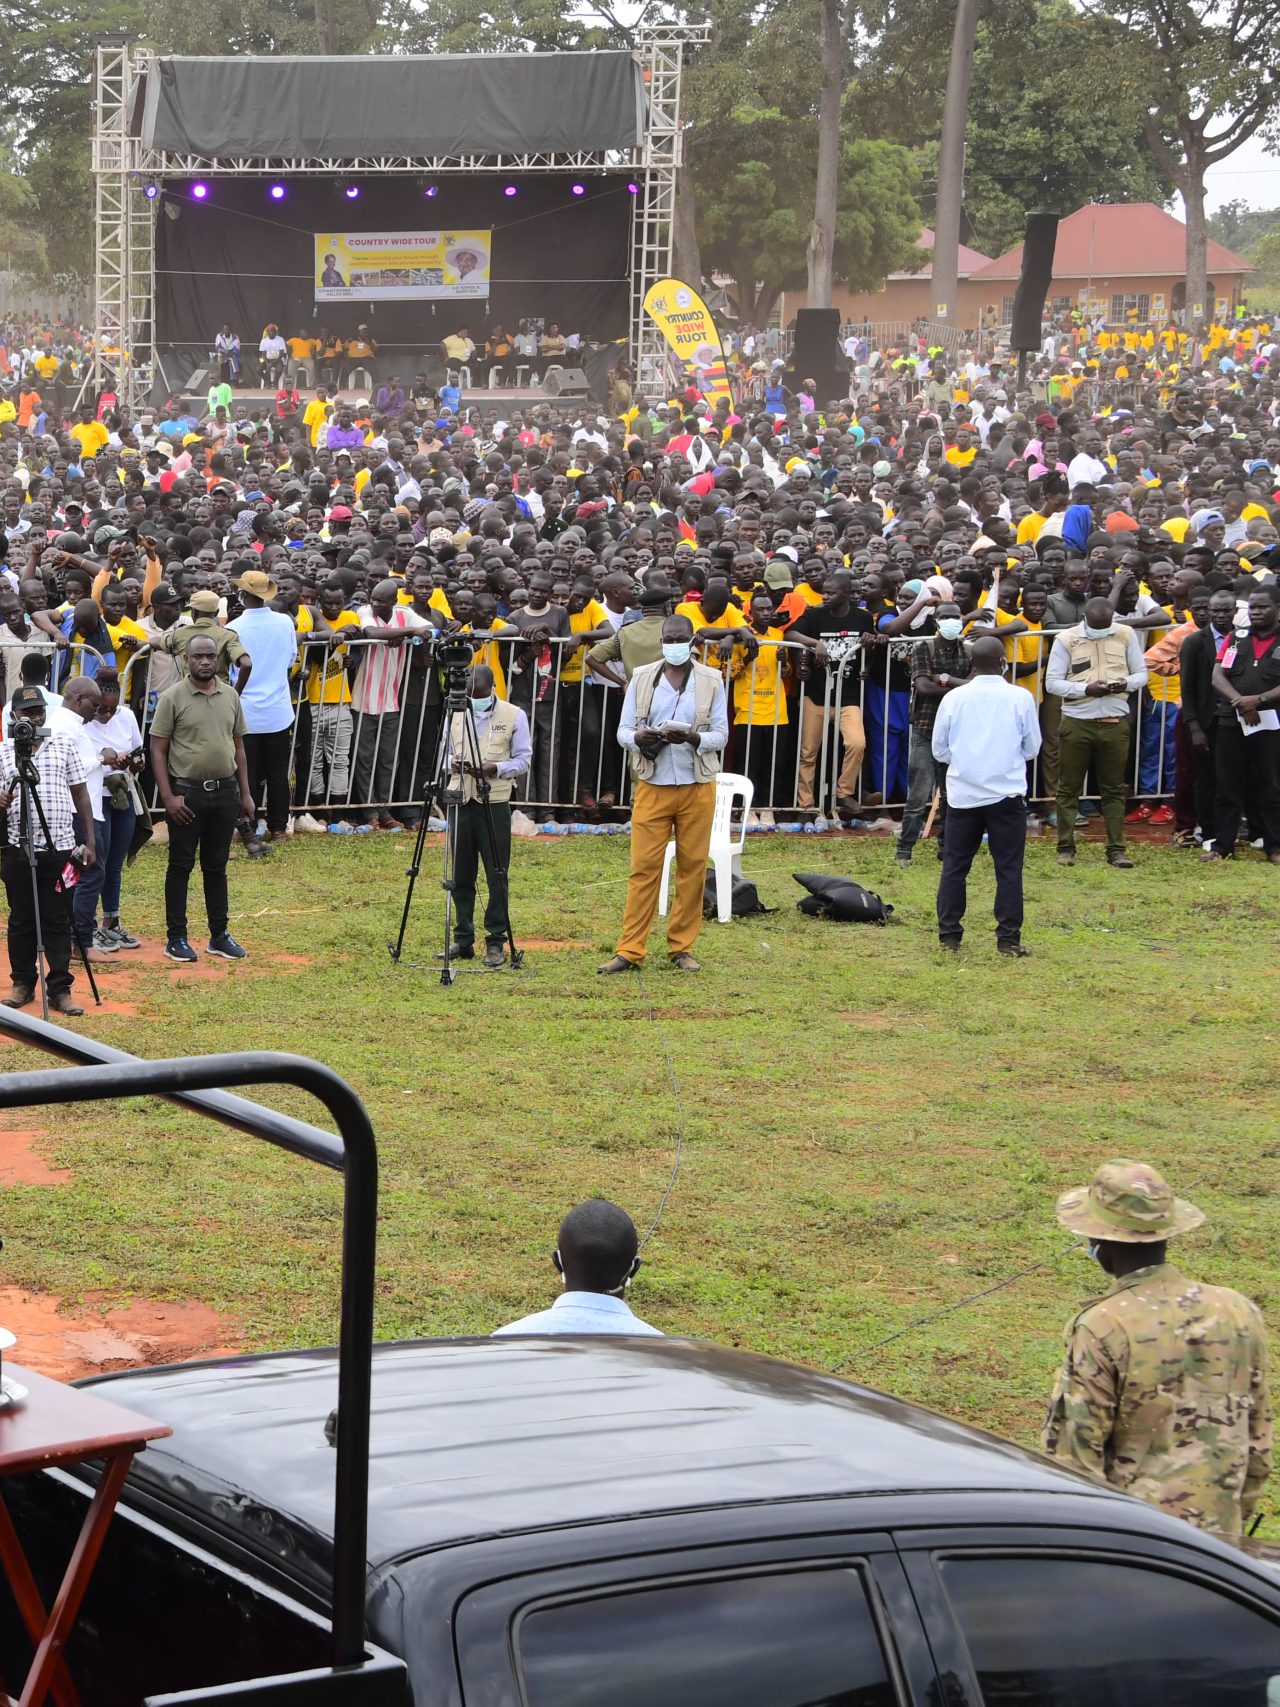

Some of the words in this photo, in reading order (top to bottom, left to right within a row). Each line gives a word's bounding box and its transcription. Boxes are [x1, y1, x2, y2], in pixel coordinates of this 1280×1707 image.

[348, 238, 390, 246] COUNTRY
[390, 237, 413, 245] WIDE
[413, 237, 437, 245] TOUR
